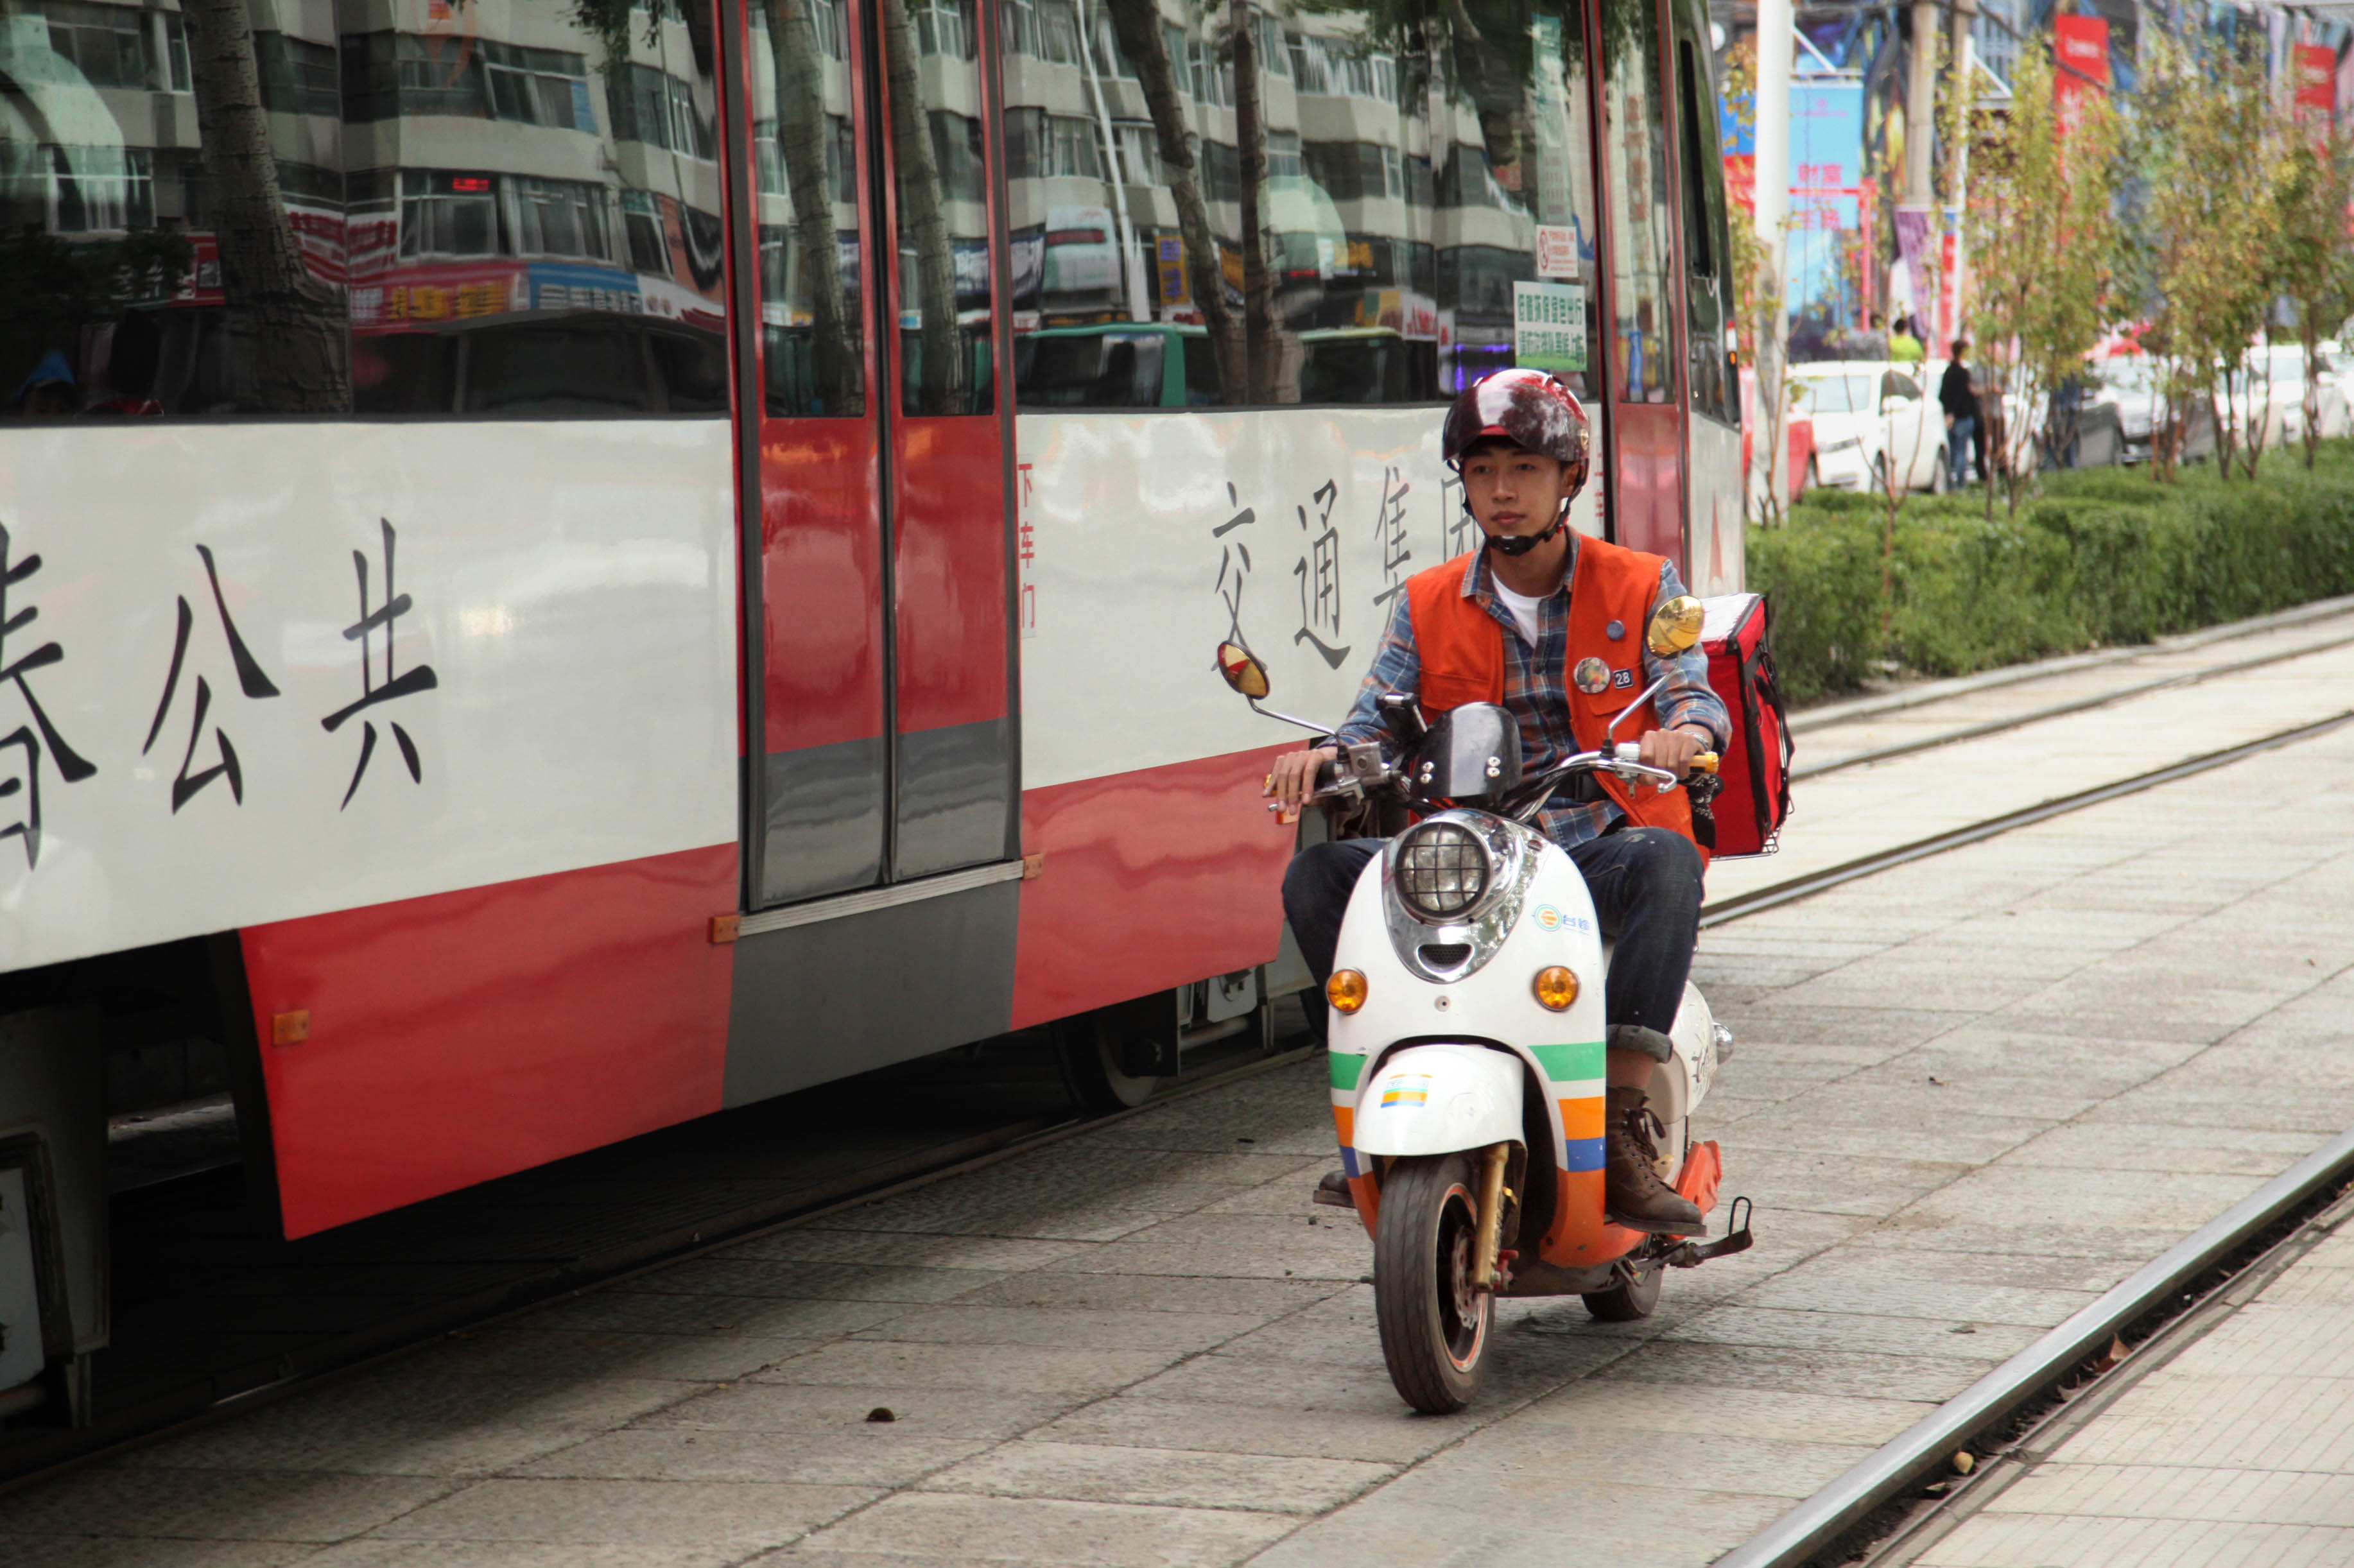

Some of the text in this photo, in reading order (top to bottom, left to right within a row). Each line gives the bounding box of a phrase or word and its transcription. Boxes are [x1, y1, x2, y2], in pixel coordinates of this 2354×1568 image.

[1017, 463, 1035, 629] 下车门
[1615, 671, 1631, 685] 28
